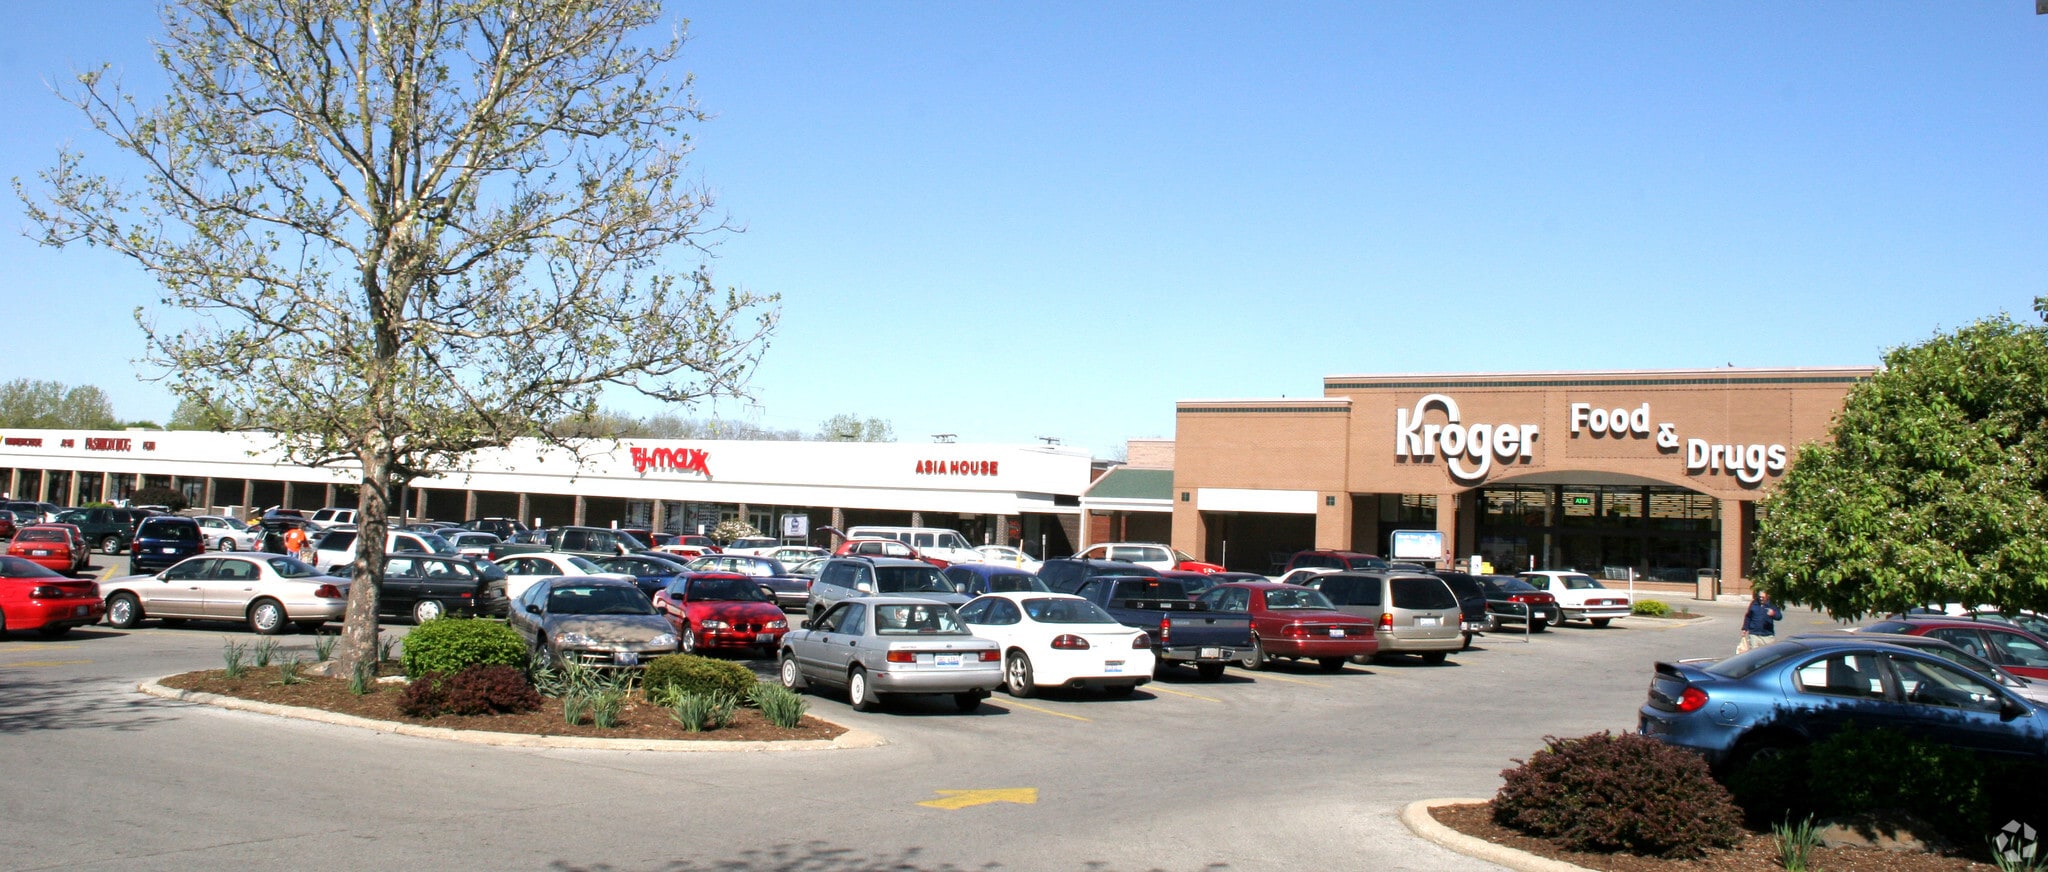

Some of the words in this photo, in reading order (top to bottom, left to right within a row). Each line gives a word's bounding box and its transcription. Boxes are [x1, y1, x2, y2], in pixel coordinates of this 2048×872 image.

[915, 459, 947, 475] ASIA
[950, 460, 999, 476] HOUSE
[1396, 394, 1539, 480] Kroger
[1570, 402, 1650, 433] Food
[1656, 423, 1680, 448] &
[1686, 438, 1787, 484] Drugs
